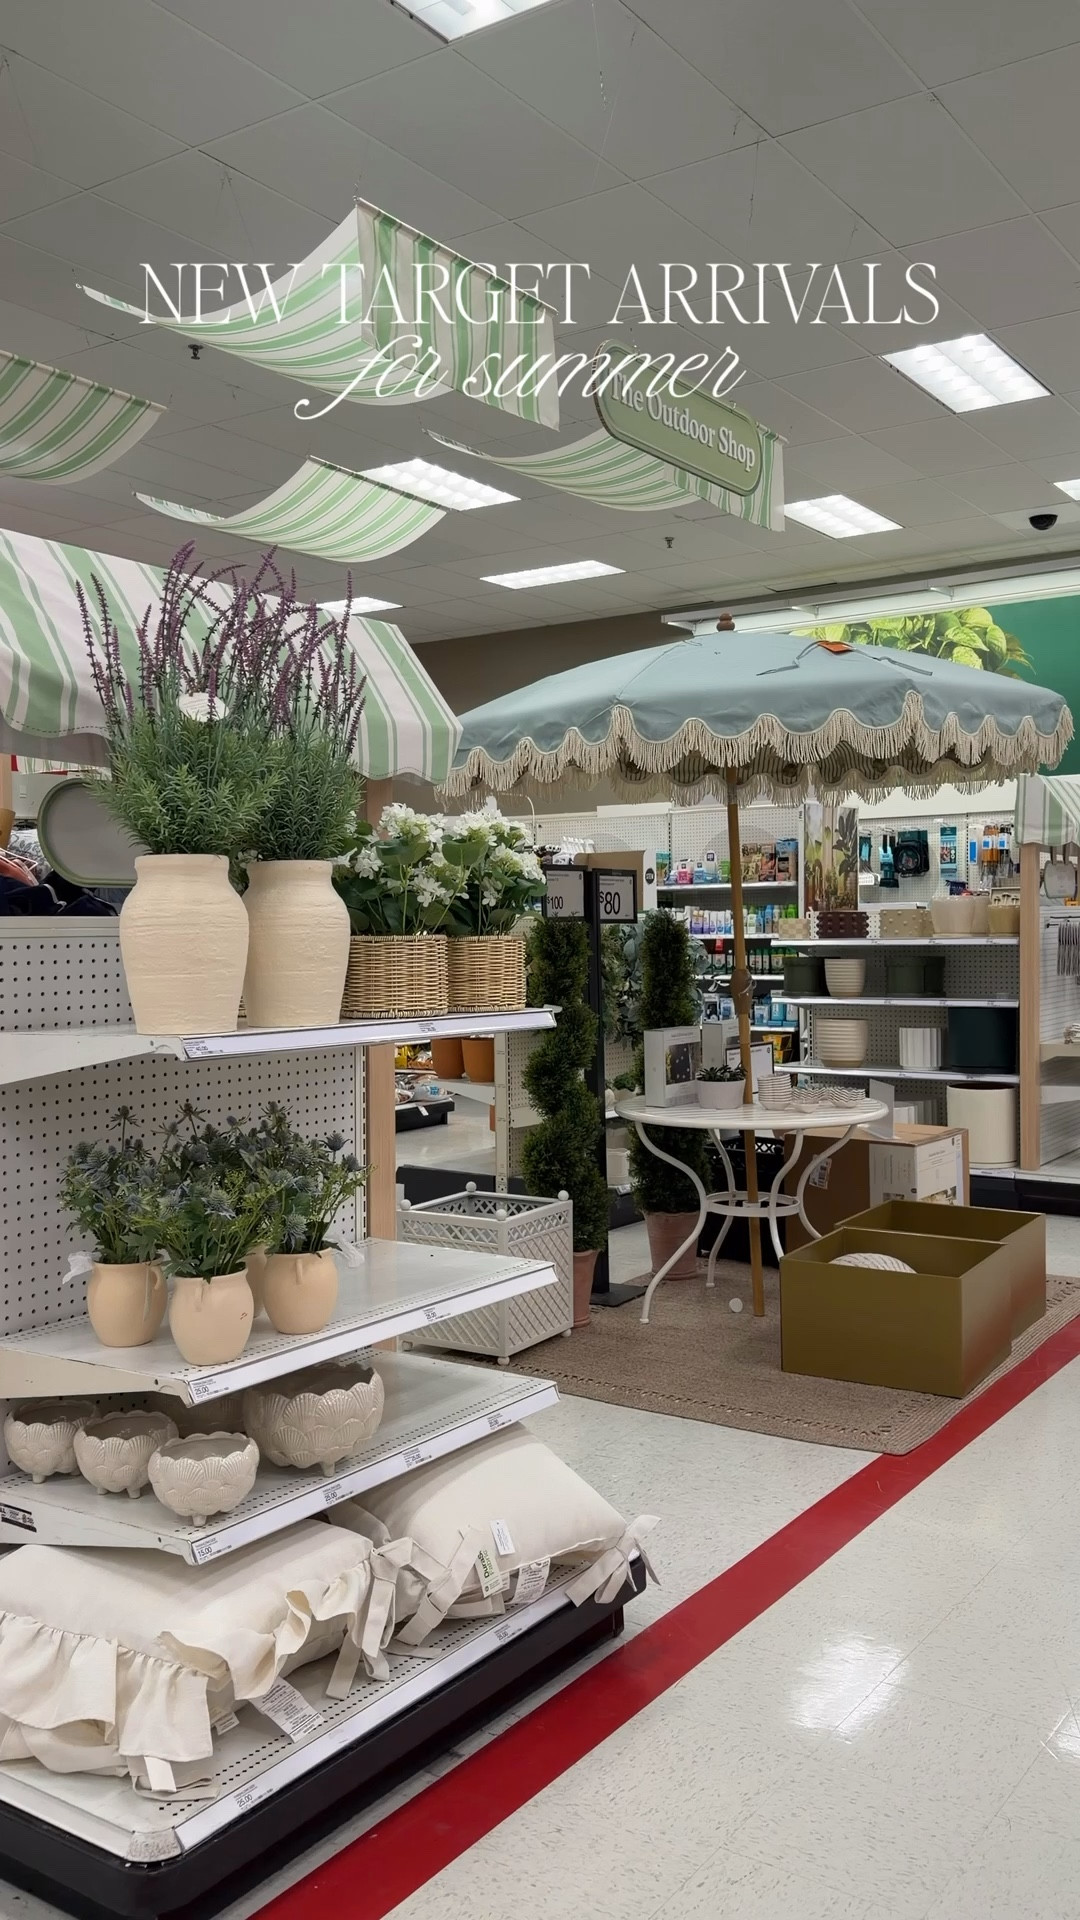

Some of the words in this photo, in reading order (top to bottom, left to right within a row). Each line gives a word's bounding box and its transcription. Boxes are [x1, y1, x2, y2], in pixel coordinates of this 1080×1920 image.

[611, 370, 644, 412] The
[646, 390, 717, 448] Outdoor
[717, 426, 756, 473] Shop
[546, 895, 564, 910] $100
[599, 890, 621, 916] $80
